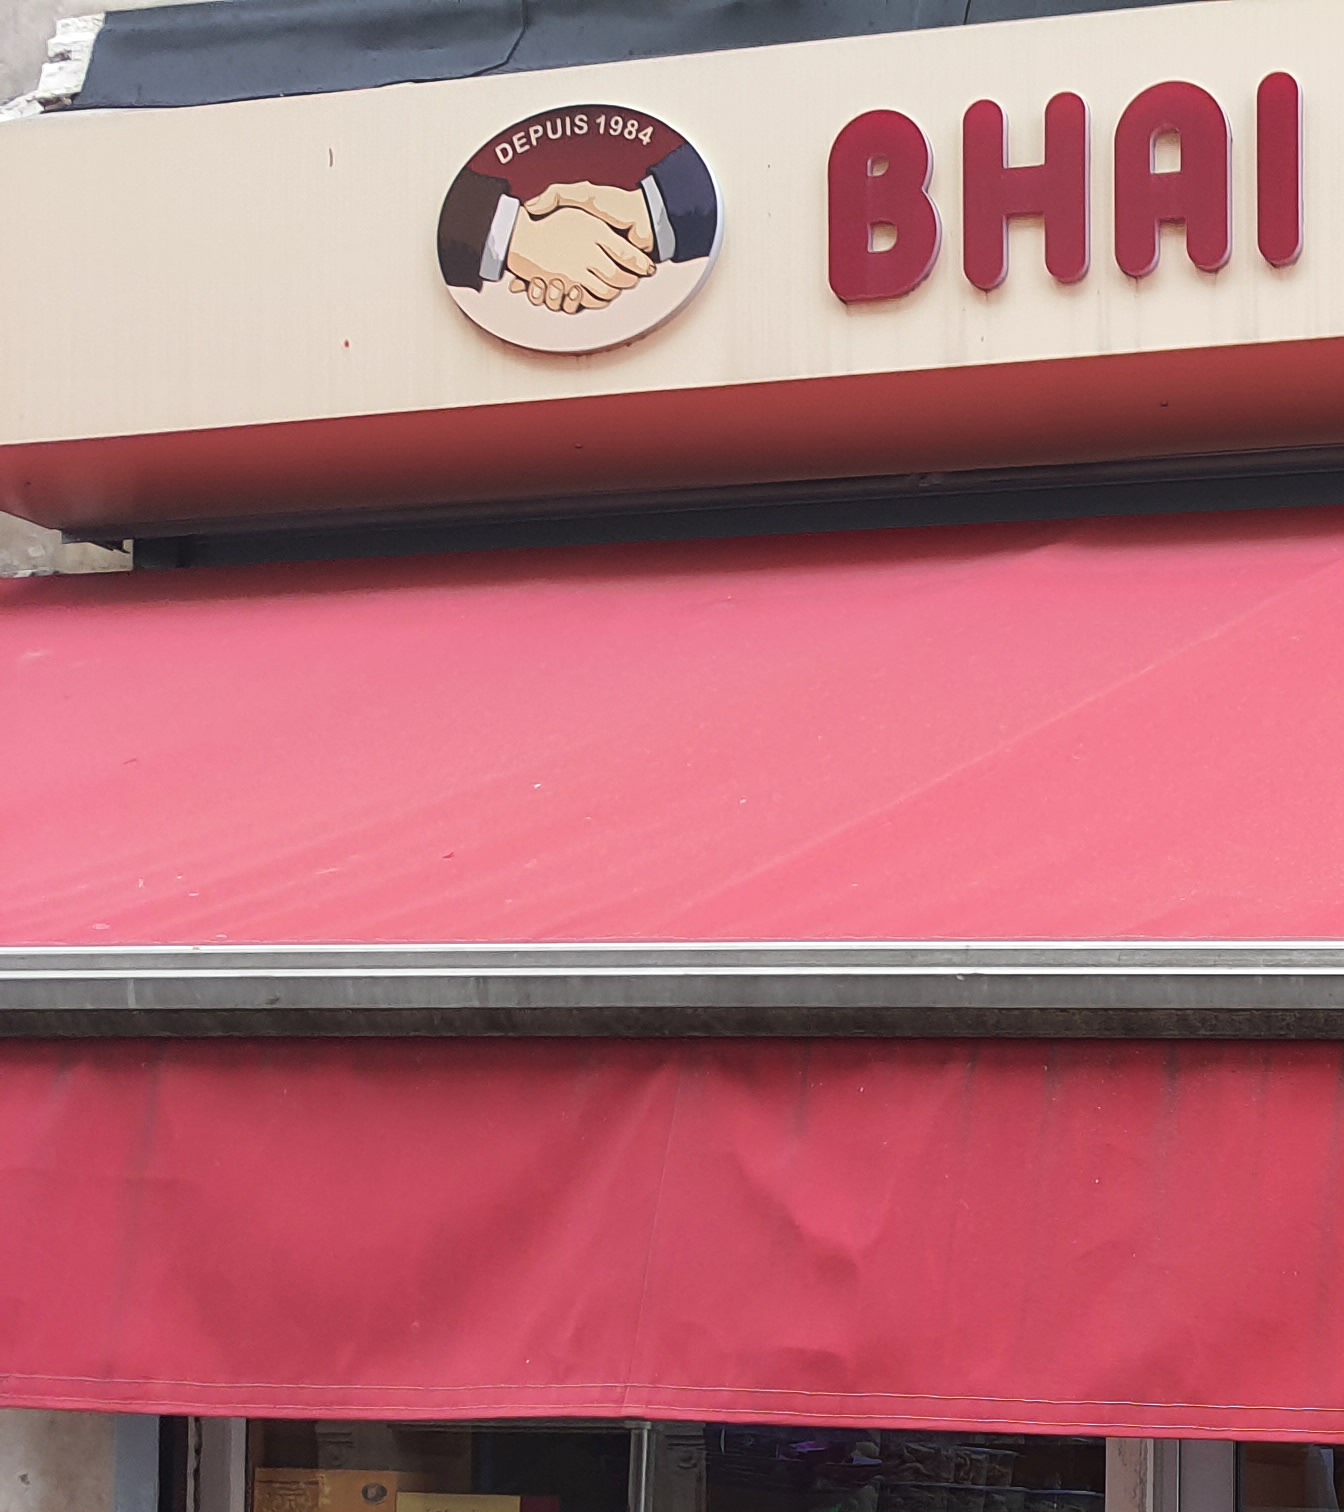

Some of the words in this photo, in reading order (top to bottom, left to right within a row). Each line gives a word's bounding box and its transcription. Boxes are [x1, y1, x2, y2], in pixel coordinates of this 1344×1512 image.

[495, 114, 588, 164] DEPUIS
[596, 114, 654, 146] 1984
[828, 72, 1304, 305] BHAI
